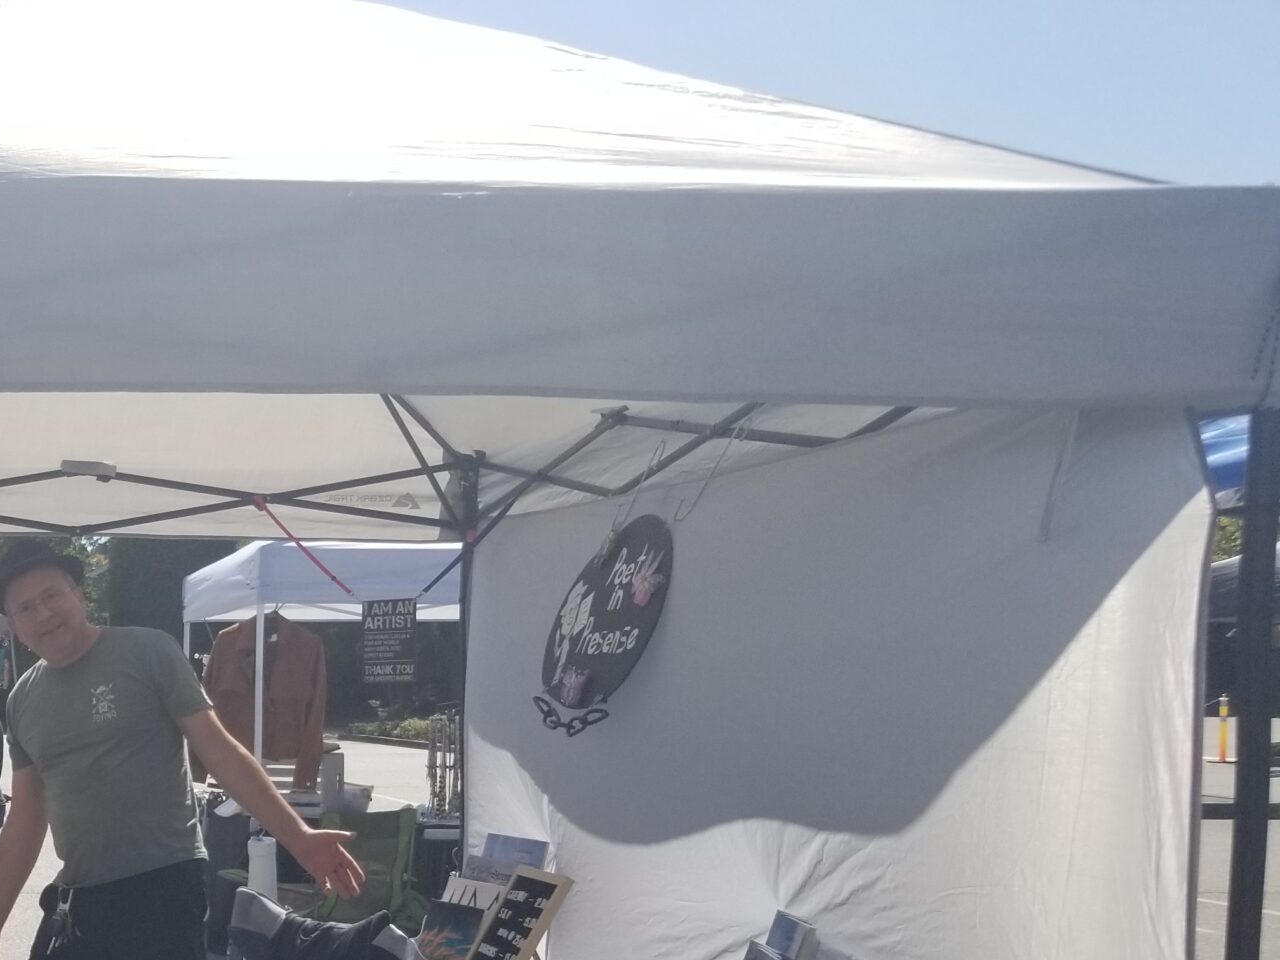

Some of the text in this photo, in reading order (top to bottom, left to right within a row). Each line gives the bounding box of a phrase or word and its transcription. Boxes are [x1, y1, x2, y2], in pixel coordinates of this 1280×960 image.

[605, 544, 648, 587] Poet
[607, 586, 624, 611] in
[363, 600, 414, 615] I AM AN
[364, 615, 413, 630] ARTIST
[364, 664, 414, 675] THANK YOU
